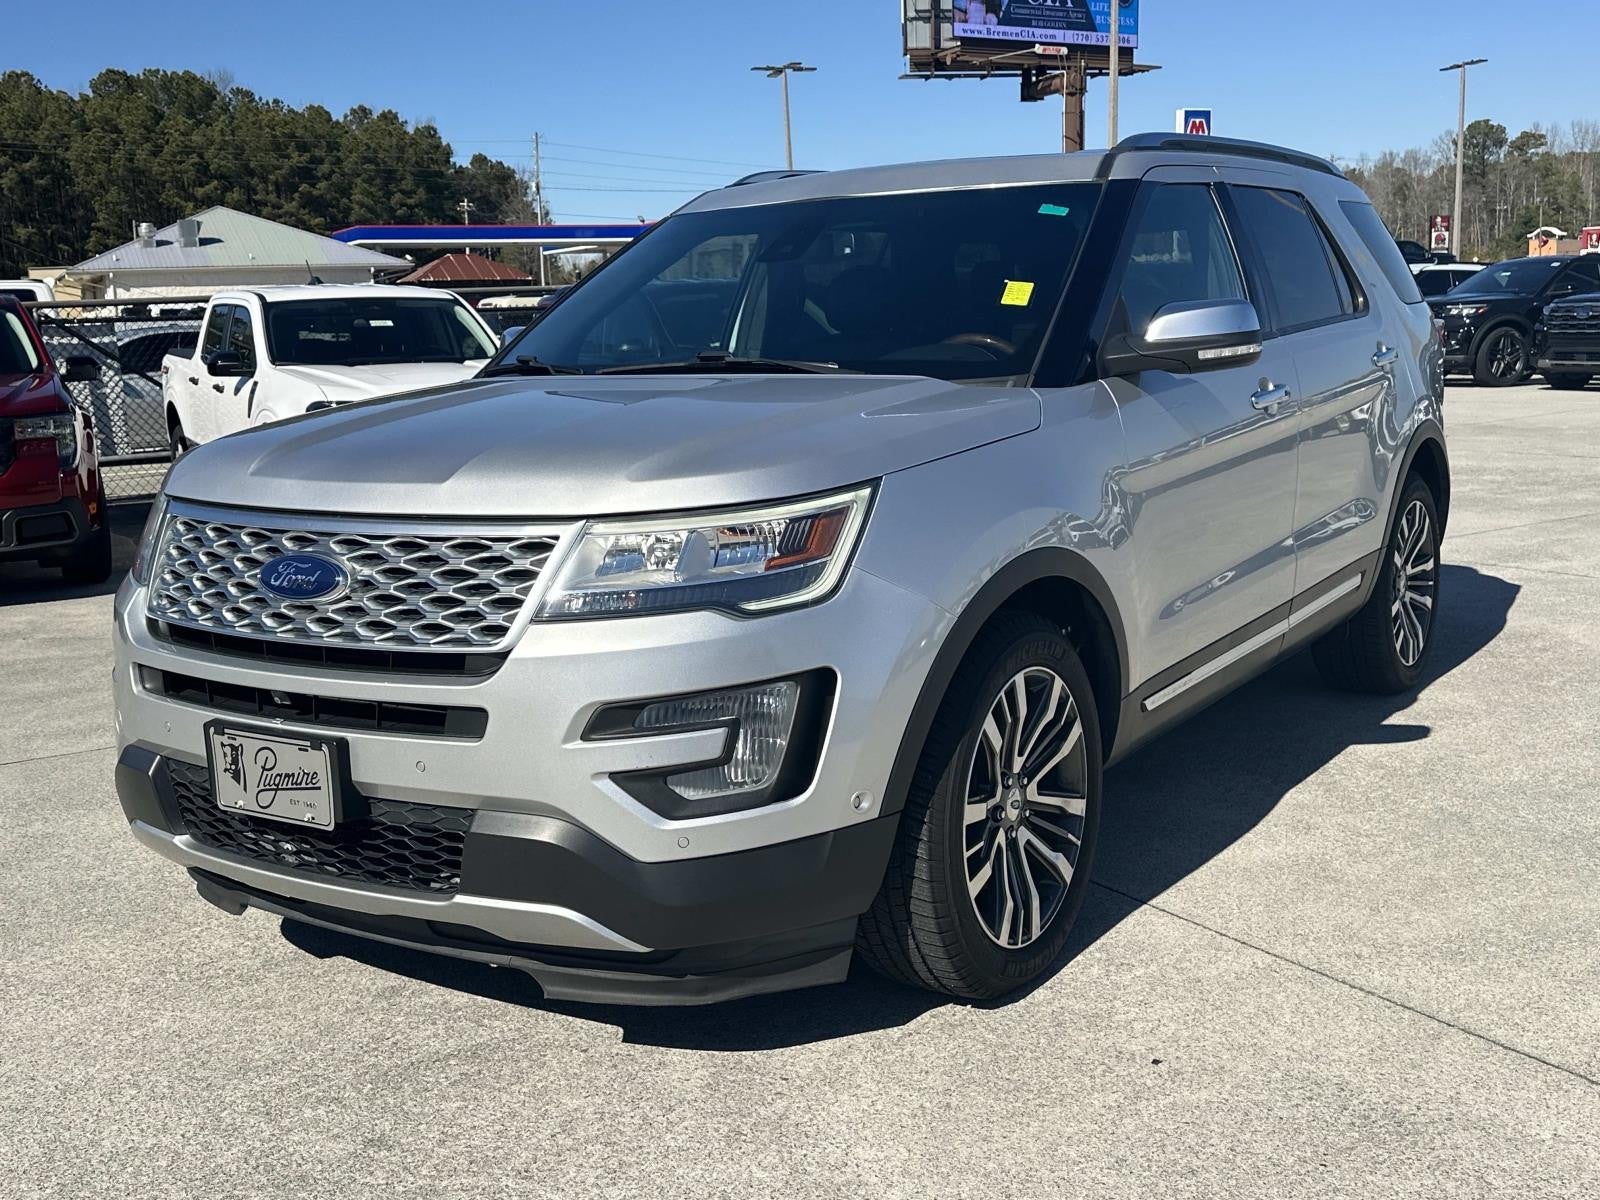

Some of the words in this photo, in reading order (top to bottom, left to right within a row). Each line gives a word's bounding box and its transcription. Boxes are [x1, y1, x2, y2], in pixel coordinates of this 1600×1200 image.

[1091, 2, 1110, 11] LIFE
[1096, 15, 1135, 25] BUSESS
[962, 27, 1057, 40] www.BremenCIA.com
[1072, 33, 1092, 43] (770)
[1188, 119, 1207, 135] M
[270, 561, 322, 588] Ford
[254, 746, 321, 809] Pugmire
